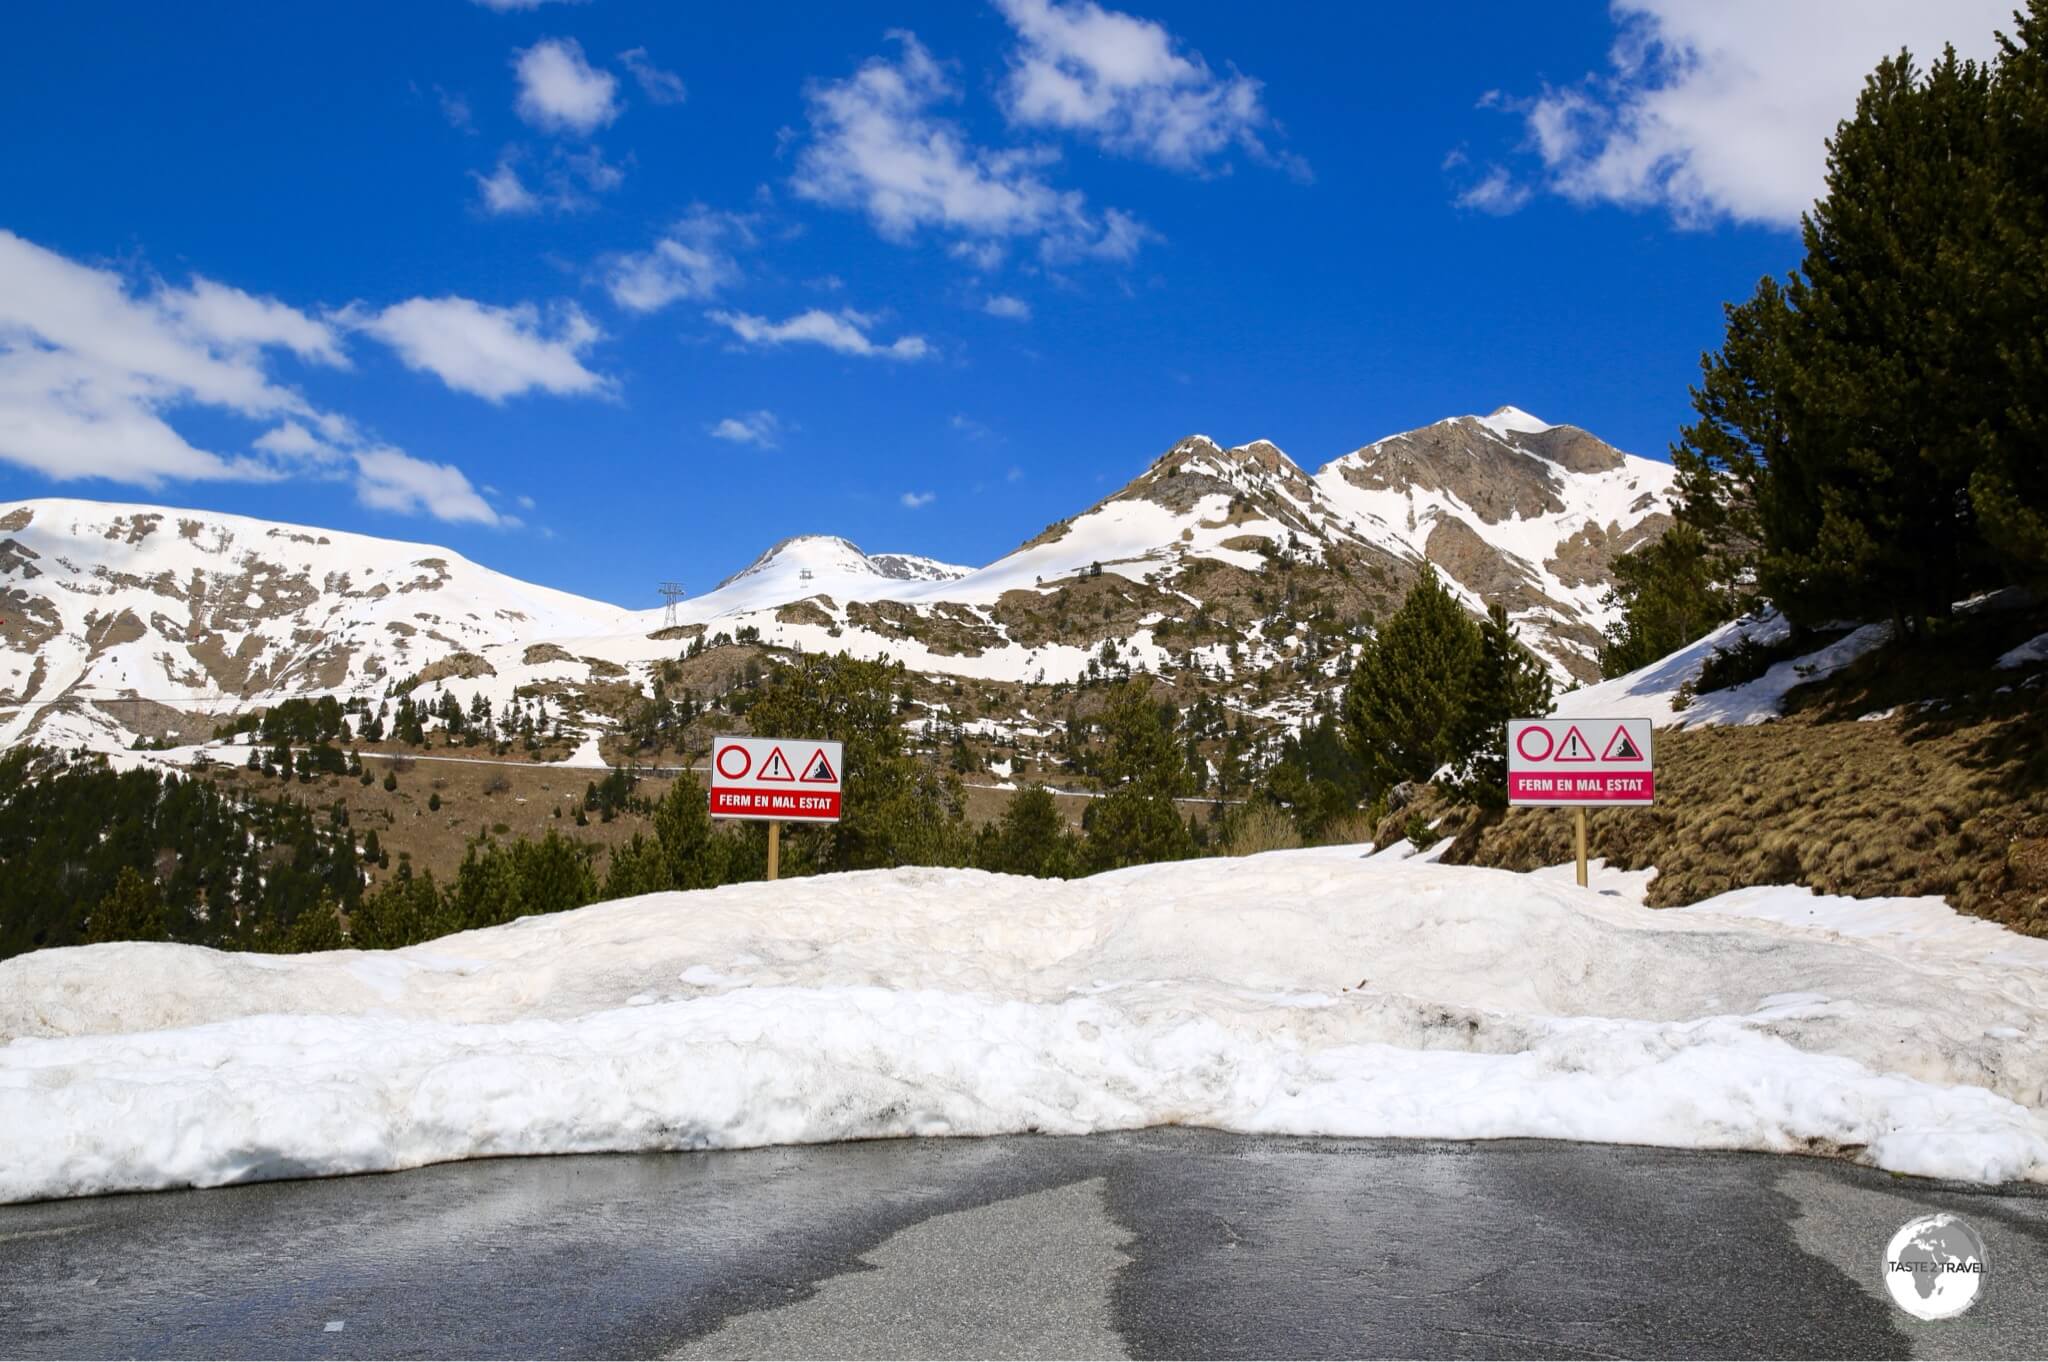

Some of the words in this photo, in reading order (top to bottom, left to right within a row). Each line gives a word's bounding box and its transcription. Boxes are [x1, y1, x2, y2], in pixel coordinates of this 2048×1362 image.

[1518, 779, 1553, 791] FERM
[1557, 779, 1573, 791] EN
[1576, 779, 1603, 791] MAL
[1606, 779, 1644, 791] ESTAT
[718, 794, 750, 806] FERM
[754, 796, 769, 807] EN
[772, 796, 796, 808] MAL
[799, 797, 832, 810] ESTAT
